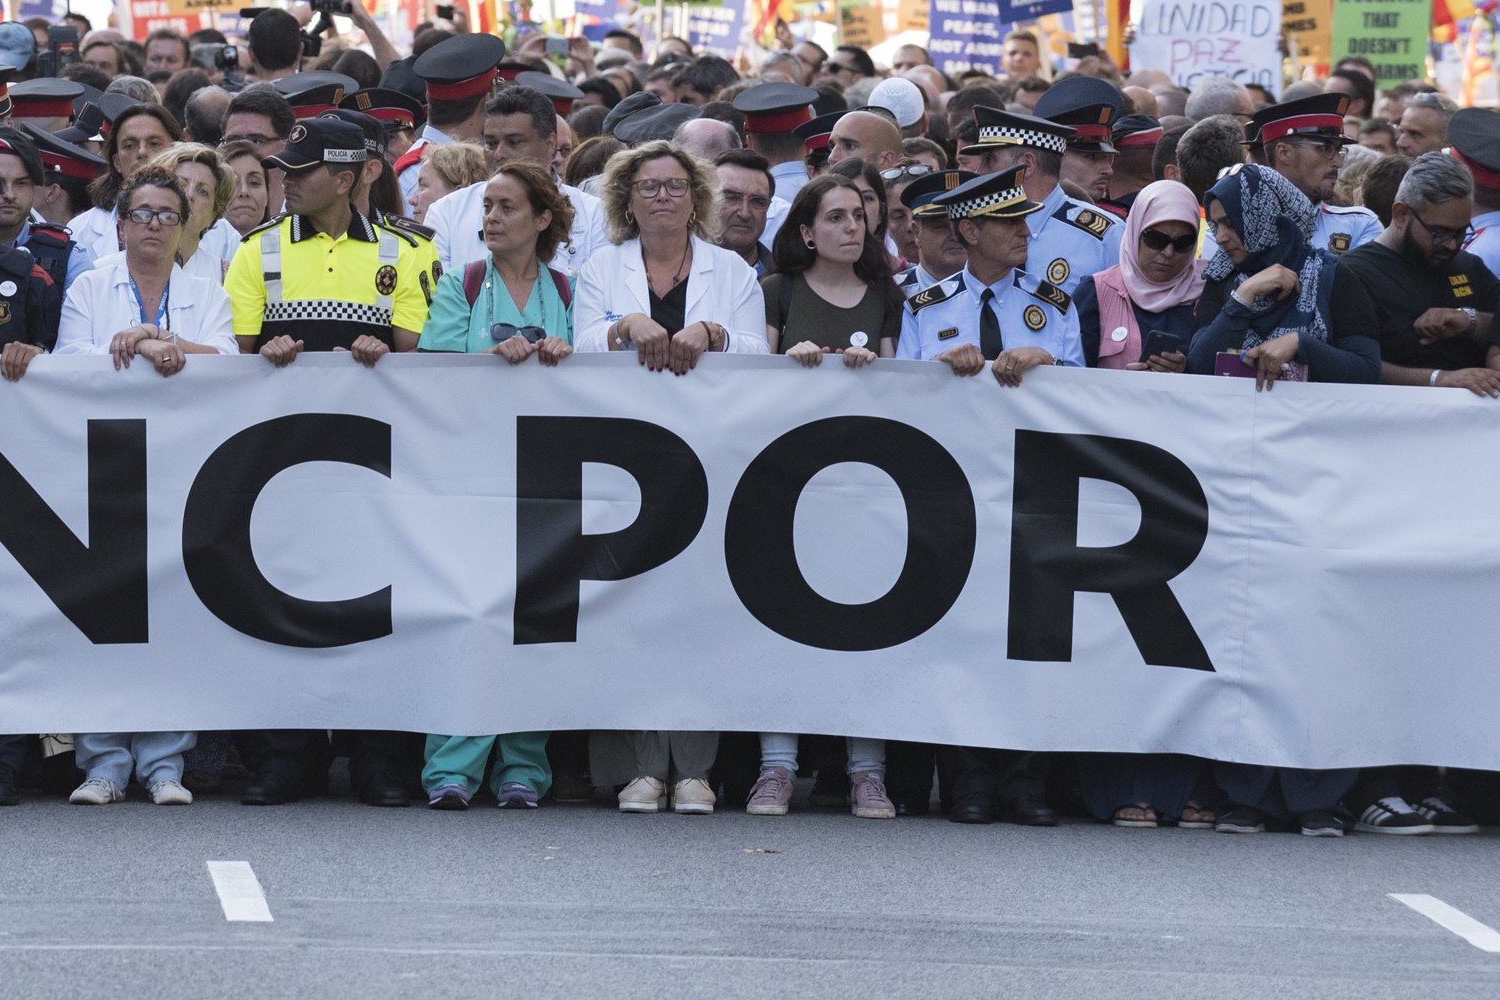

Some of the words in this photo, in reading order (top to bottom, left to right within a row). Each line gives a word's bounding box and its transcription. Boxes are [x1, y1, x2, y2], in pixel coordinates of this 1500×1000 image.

[962, 0, 999, 16] WAN
[1282, 18, 1316, 32] MES
[1362, 11, 1399, 28] THAT
[943, 19, 999, 39] PEACE,
[930, 38, 963, 53] NOT
[1348, 36, 1411, 54] DOESN'T
[1170, 37, 1241, 75] PAZ
[1375, 63, 1418, 80] ARMS
[513, 413, 1217, 673] POR
